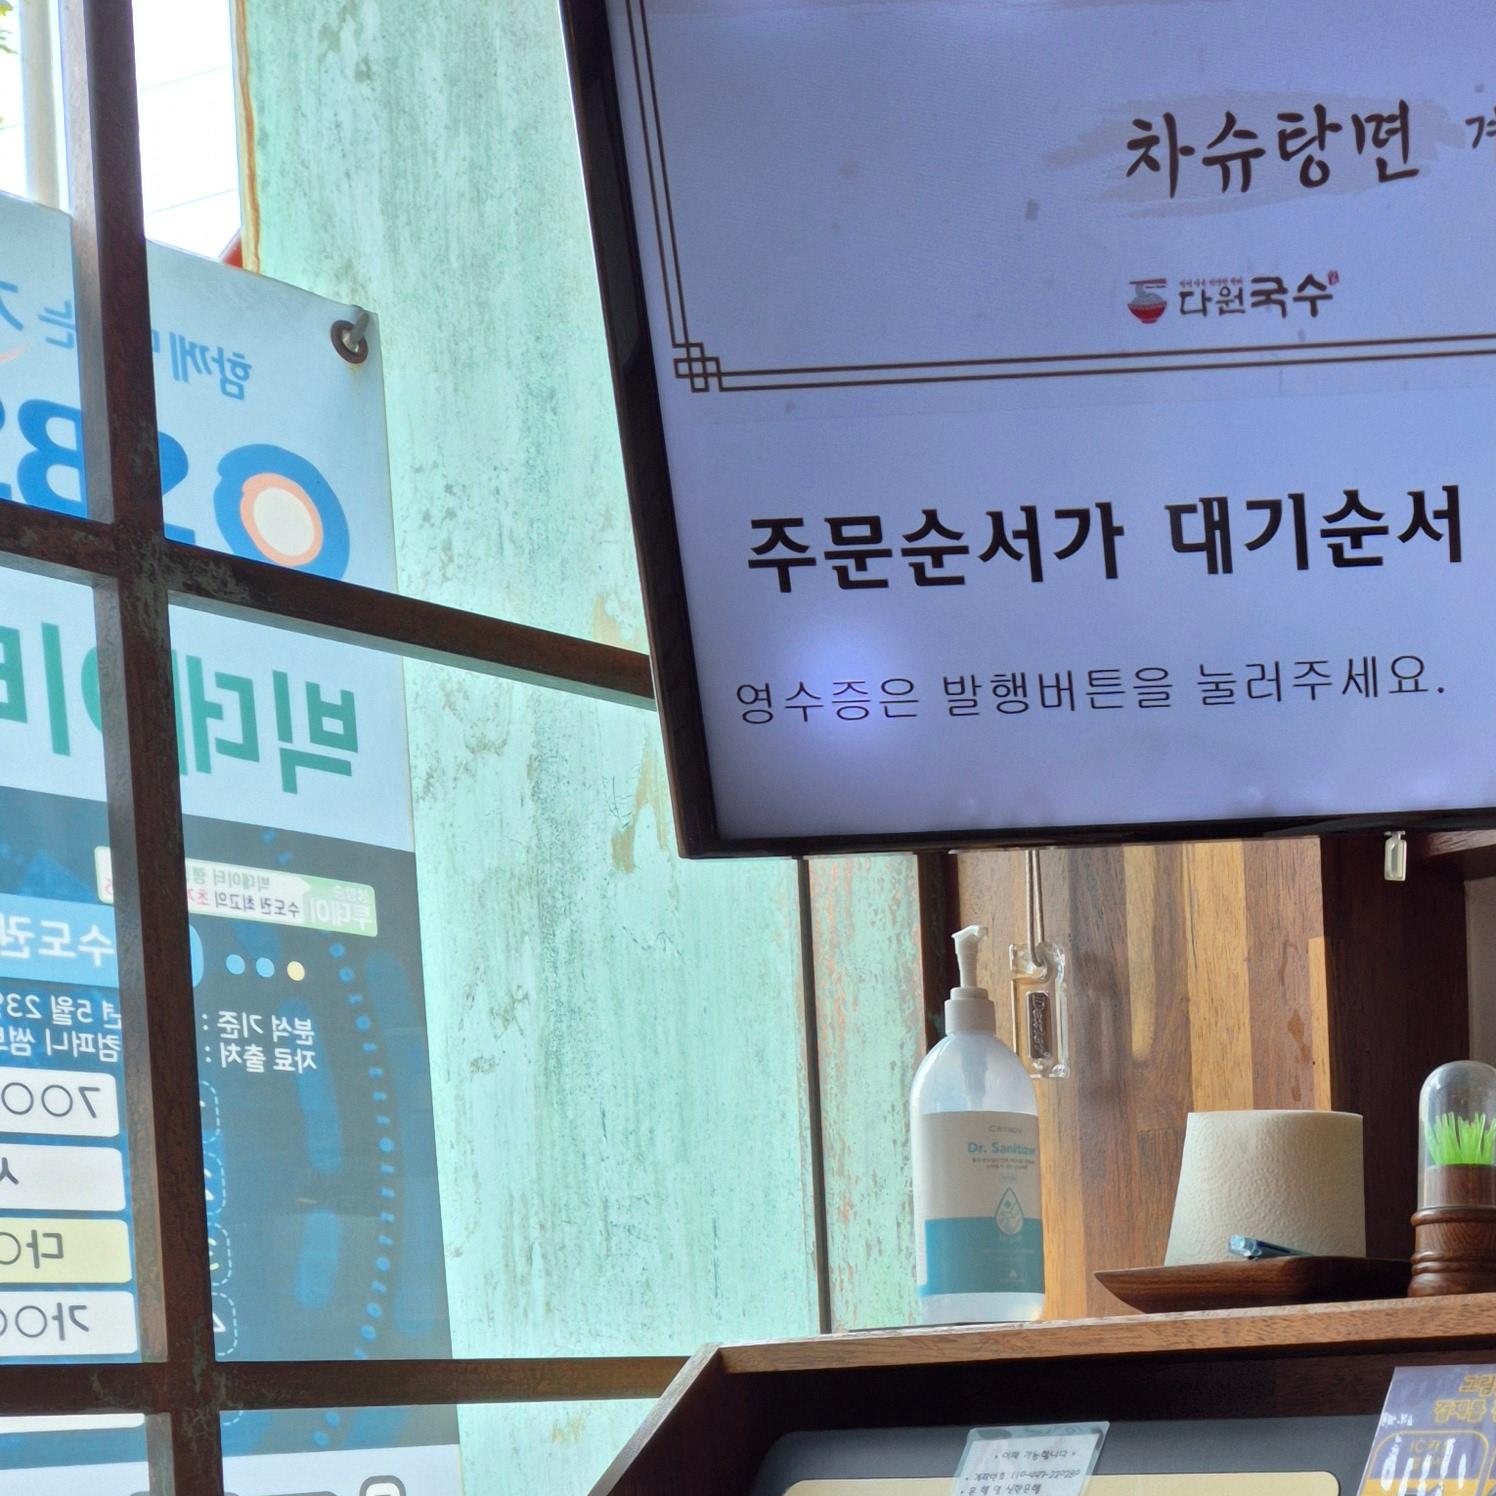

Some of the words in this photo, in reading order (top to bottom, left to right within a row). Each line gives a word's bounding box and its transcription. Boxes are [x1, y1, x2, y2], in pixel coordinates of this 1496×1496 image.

[1126, 98, 1420, 199] 차슈탕면
[1178, 273, 1334, 319] 다원국수
[746, 501, 1126, 594] 주문순서가
[1164, 484, 1463, 576] 대기순서
[735, 676, 921, 726] 영수증은
[942, 664, 1174, 716] 발행버튼을
[1196, 654, 1447, 707] 눌러주세요.
[967, 1141, 987, 1154] Dr.
